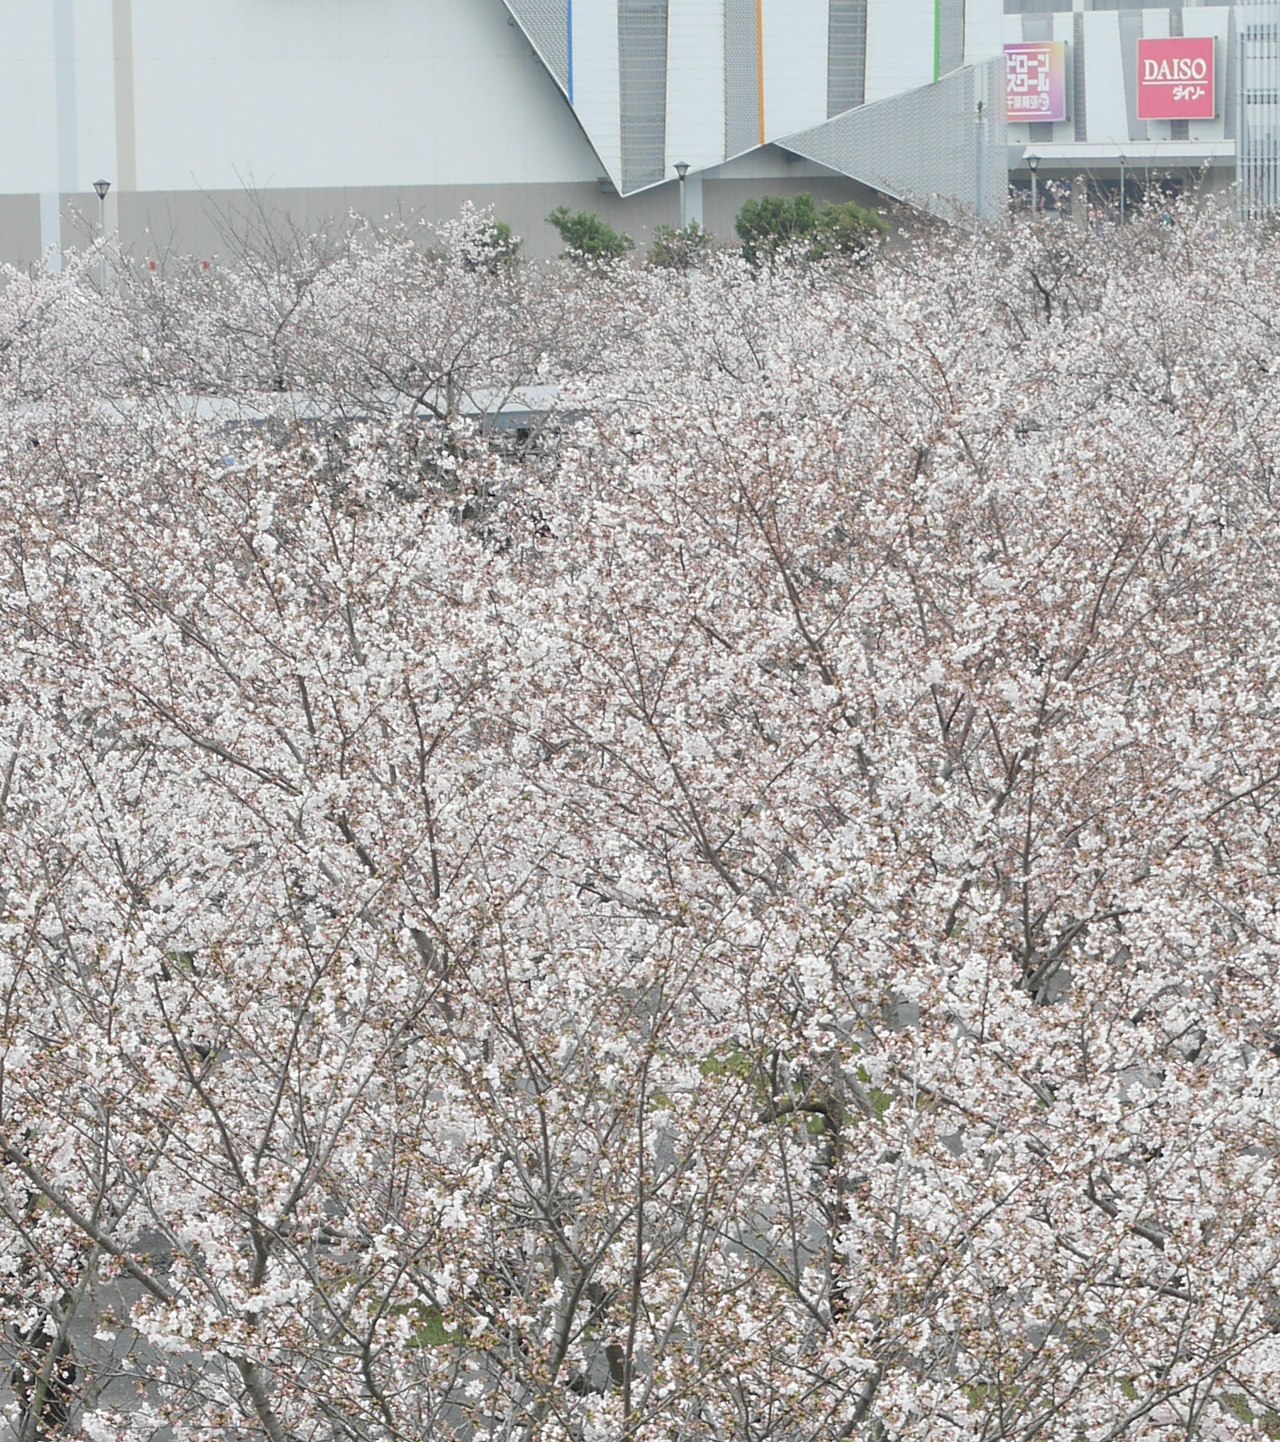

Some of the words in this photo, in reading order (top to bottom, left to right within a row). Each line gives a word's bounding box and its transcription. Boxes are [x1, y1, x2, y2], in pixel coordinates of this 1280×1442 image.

[1007, 54, 1049, 73] ドローン
[1144, 58, 1206, 80] DAISO
[1007, 73, 1049, 92] スクール
[1172, 85, 1205, 100] ダイソー
